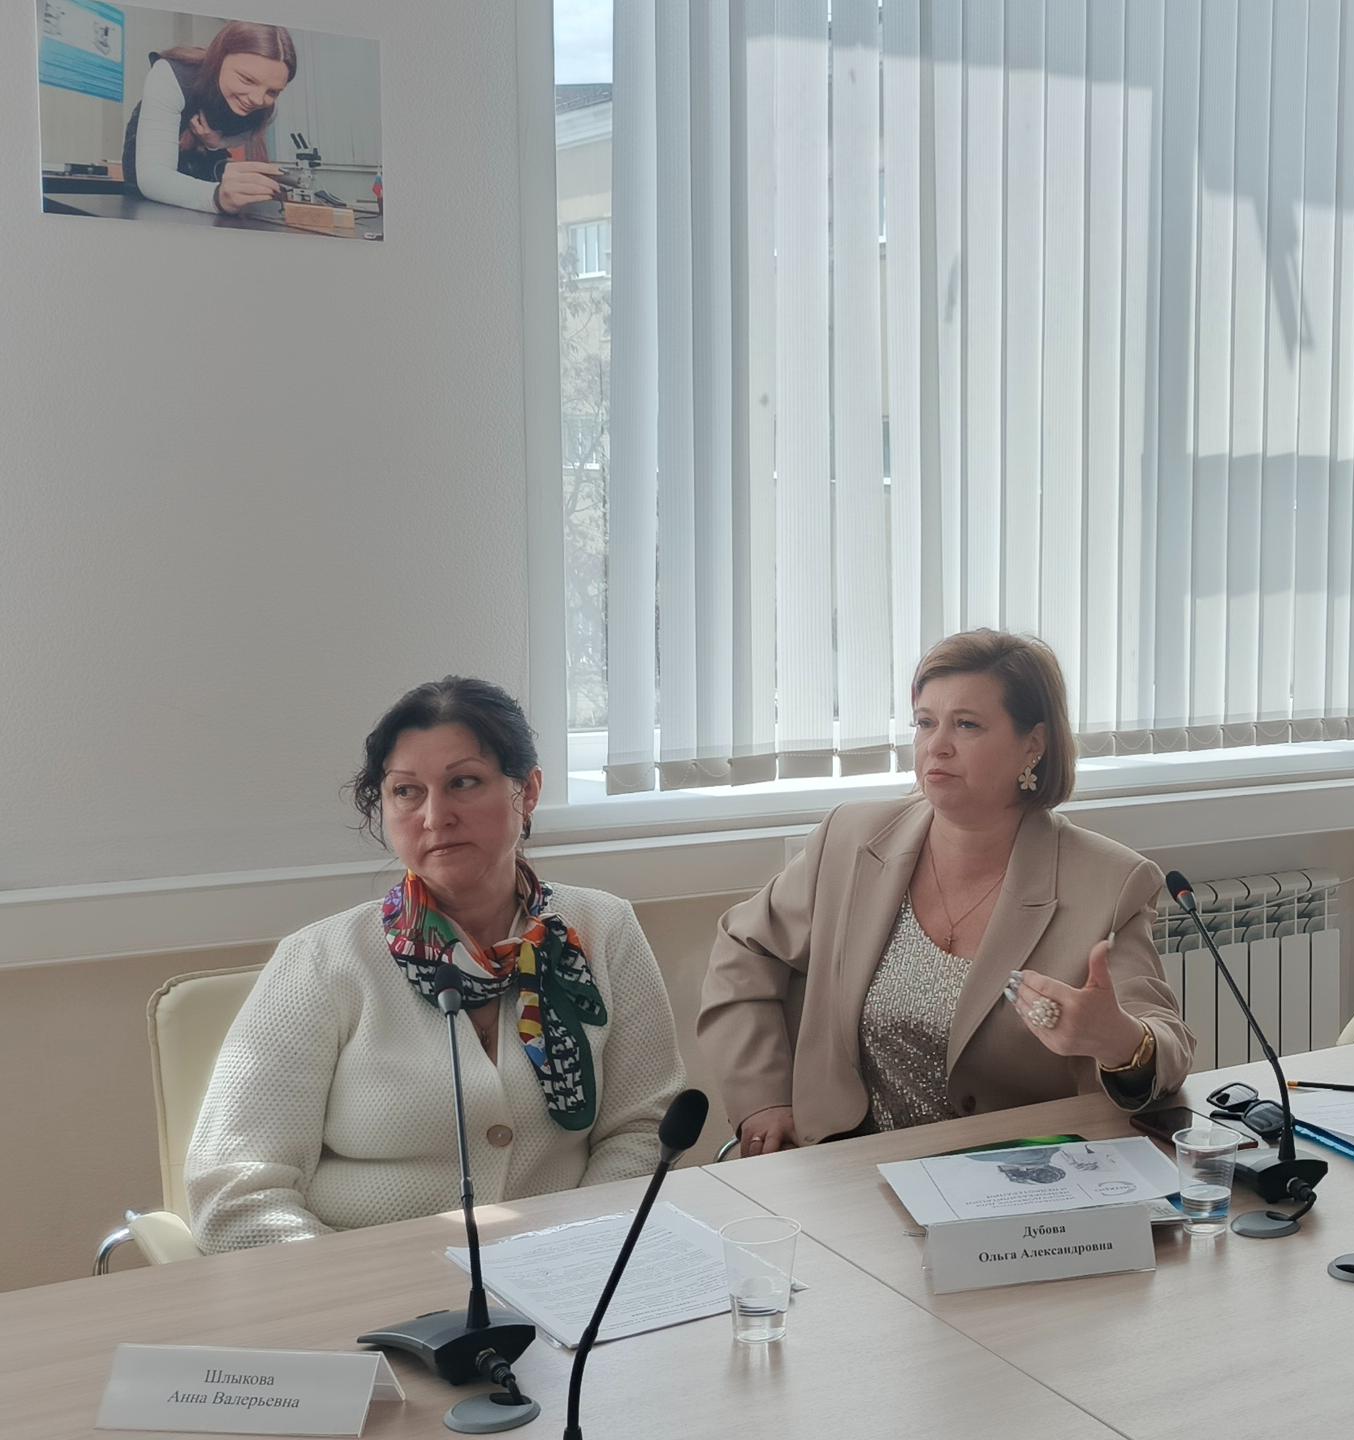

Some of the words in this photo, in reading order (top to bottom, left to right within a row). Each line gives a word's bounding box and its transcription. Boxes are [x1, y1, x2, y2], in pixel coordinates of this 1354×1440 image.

[1022, 1223, 1067, 1239] Дубова
[978, 1250, 1017, 1263] Ольга
[1020, 1240, 1113, 1260] Александровна
[204, 1369, 275, 1386] Шлыкова
[167, 1390, 207, 1404] Анна
[213, 1391, 300, 1410] Валерьевна
